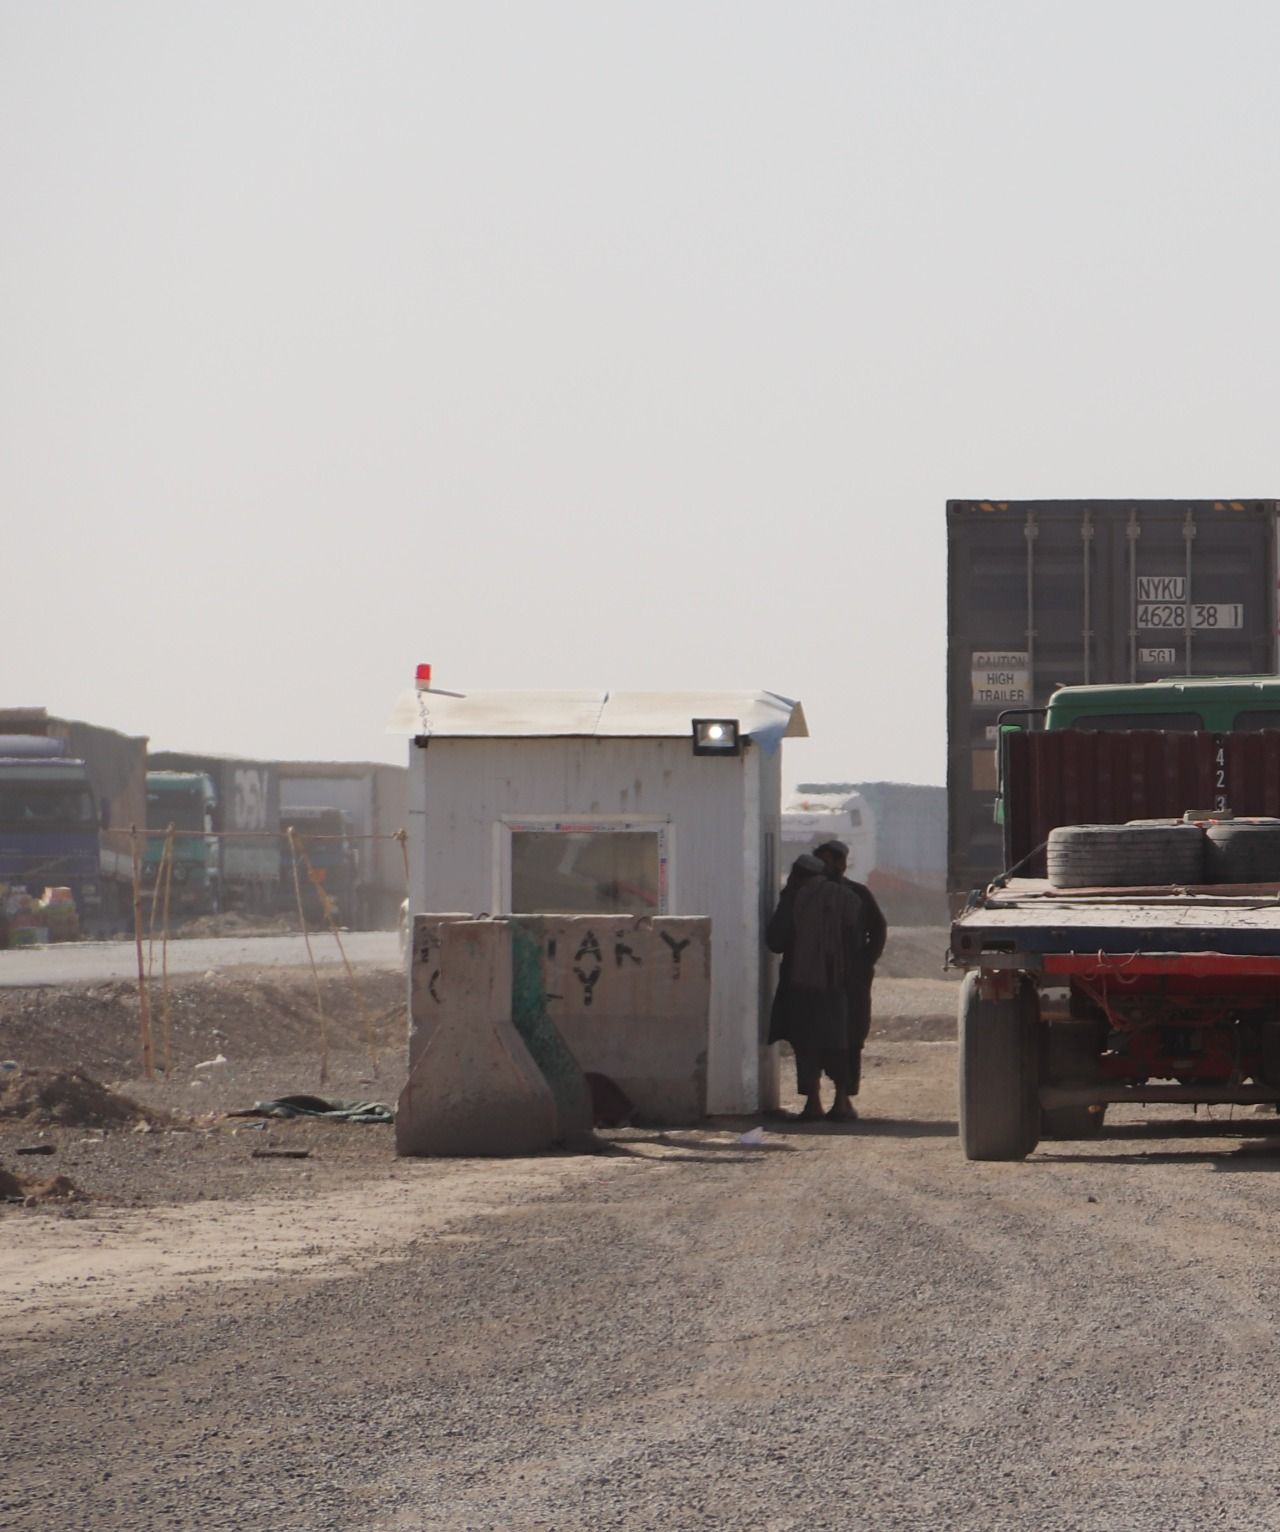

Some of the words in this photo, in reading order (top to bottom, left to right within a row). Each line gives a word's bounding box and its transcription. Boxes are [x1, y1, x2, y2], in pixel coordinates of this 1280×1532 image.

[1138, 578, 1185, 600] NYKU
[977, 655, 1025, 669] CAUTION
[986, 672, 1015, 685] HIGH
[978, 689, 1025, 702] TRAILER
